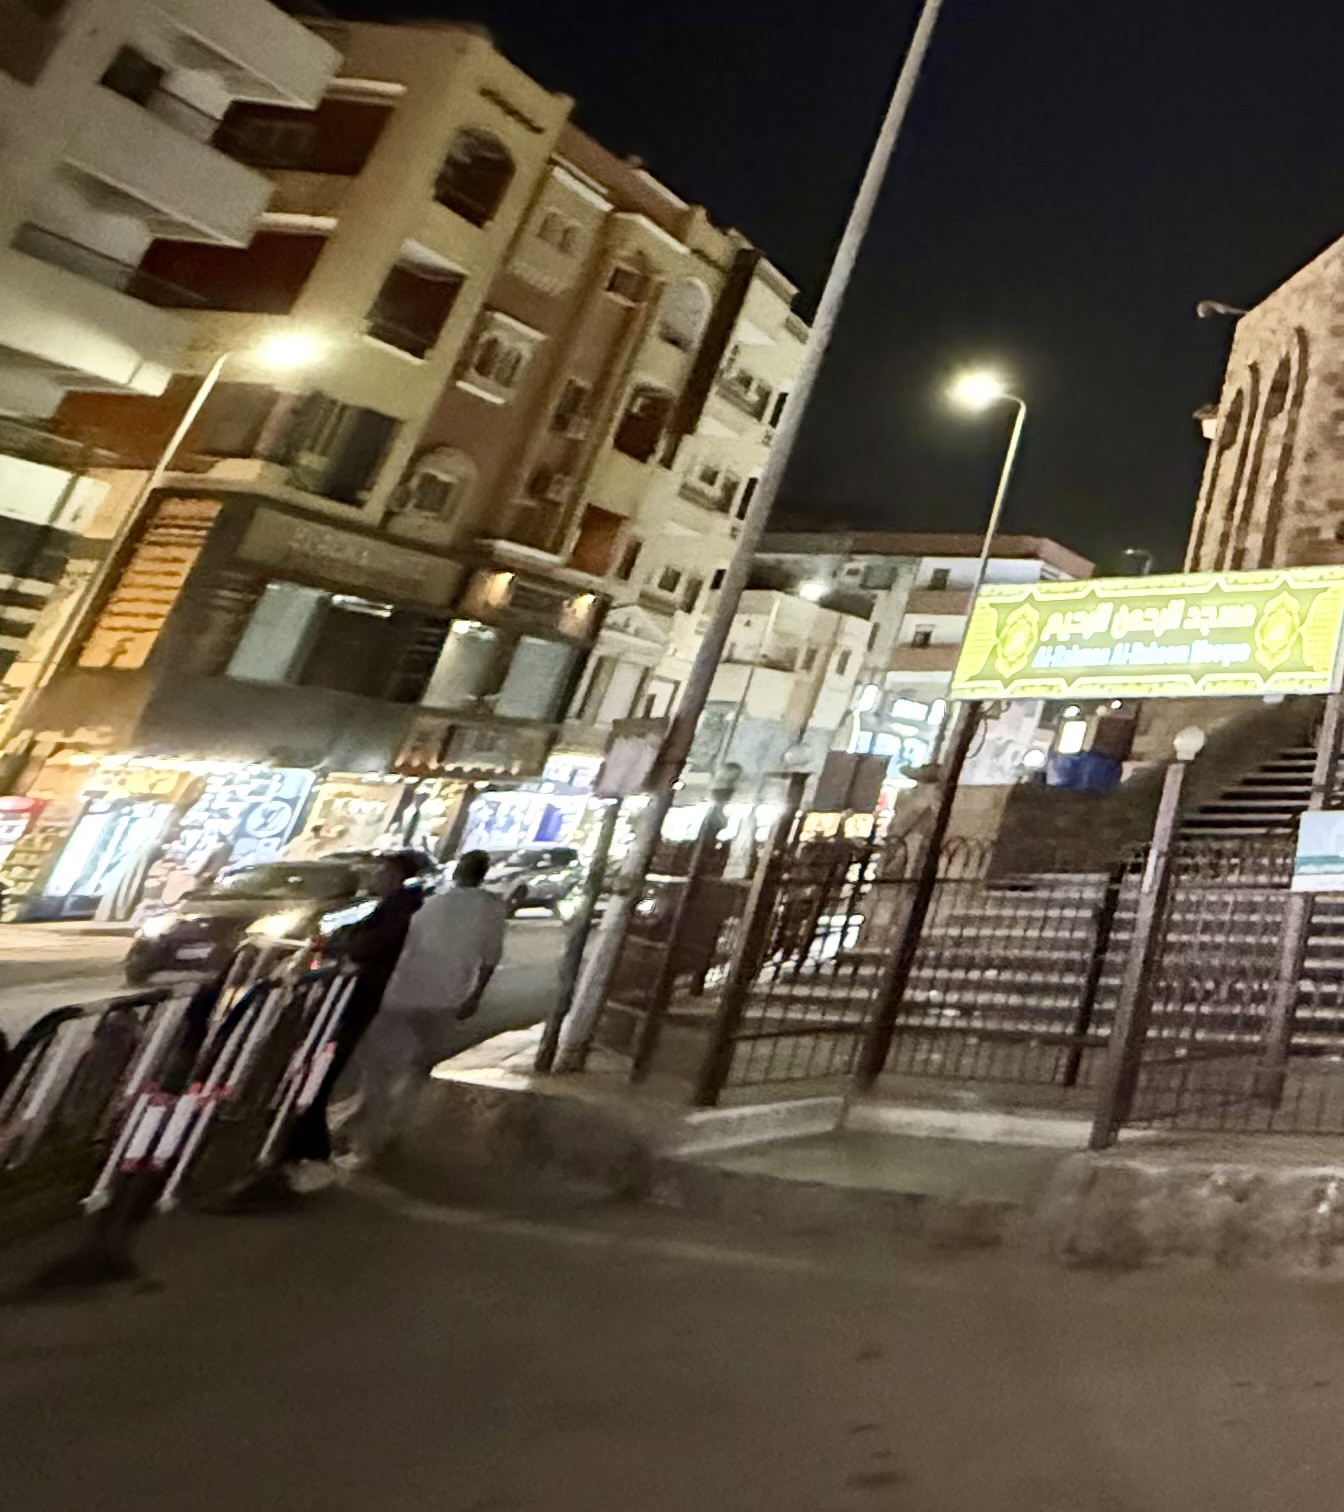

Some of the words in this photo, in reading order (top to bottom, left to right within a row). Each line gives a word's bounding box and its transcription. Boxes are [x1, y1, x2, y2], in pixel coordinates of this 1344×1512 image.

[1040, 602, 1114, 642] الرحيم
[1111, 599, 1185, 639] الرحمن
[1183, 604, 1257, 636] مسجد
